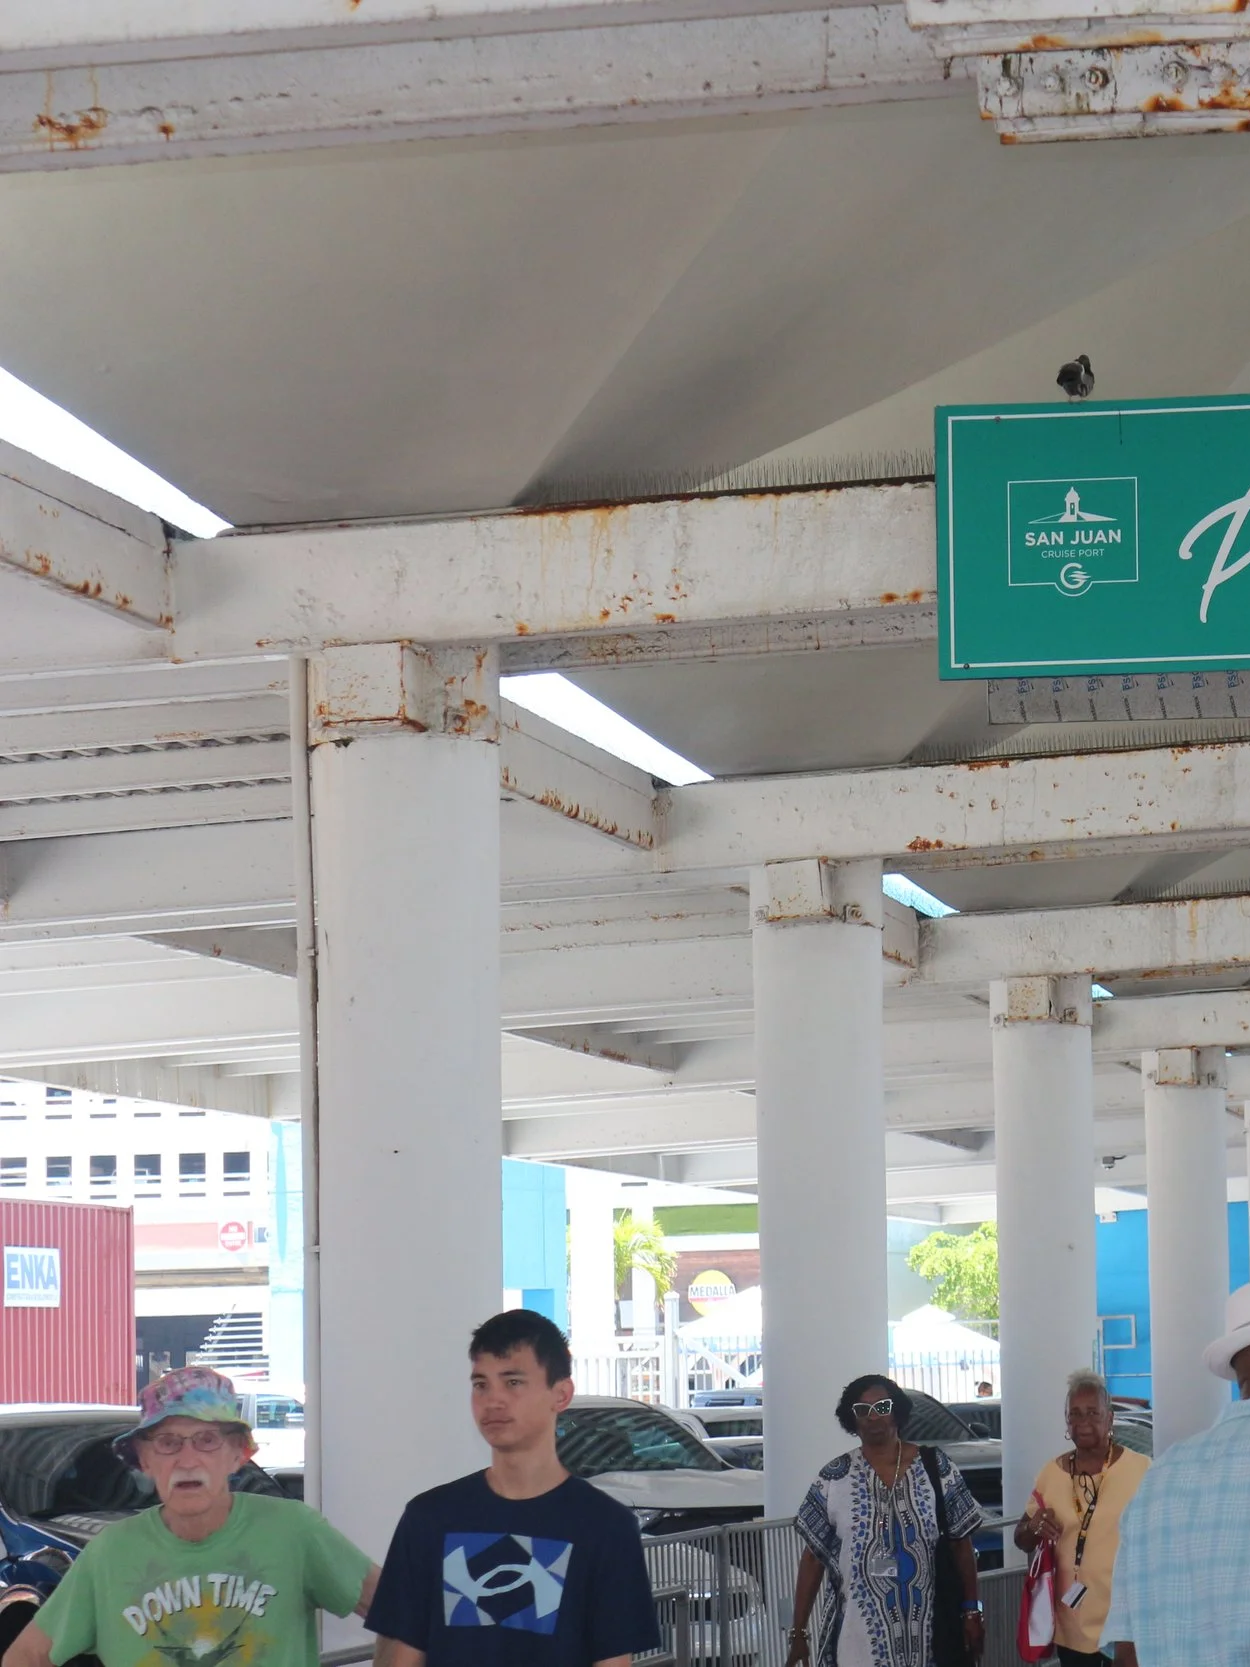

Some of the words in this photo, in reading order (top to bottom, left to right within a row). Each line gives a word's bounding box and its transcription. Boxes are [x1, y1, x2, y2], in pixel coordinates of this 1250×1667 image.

[1025, 531, 1064, 547] SAN
[1070, 528, 1122, 545] JUAN
[1041, 549, 1076, 559] CRUISE
[1078, 548, 1105, 558] PORT
[6, 1253, 58, 1290] ENKA
[690, 1285, 736, 1297] MEDALLA
[122, 1575, 201, 1636] DOWN
[207, 1572, 278, 1617] TIME
